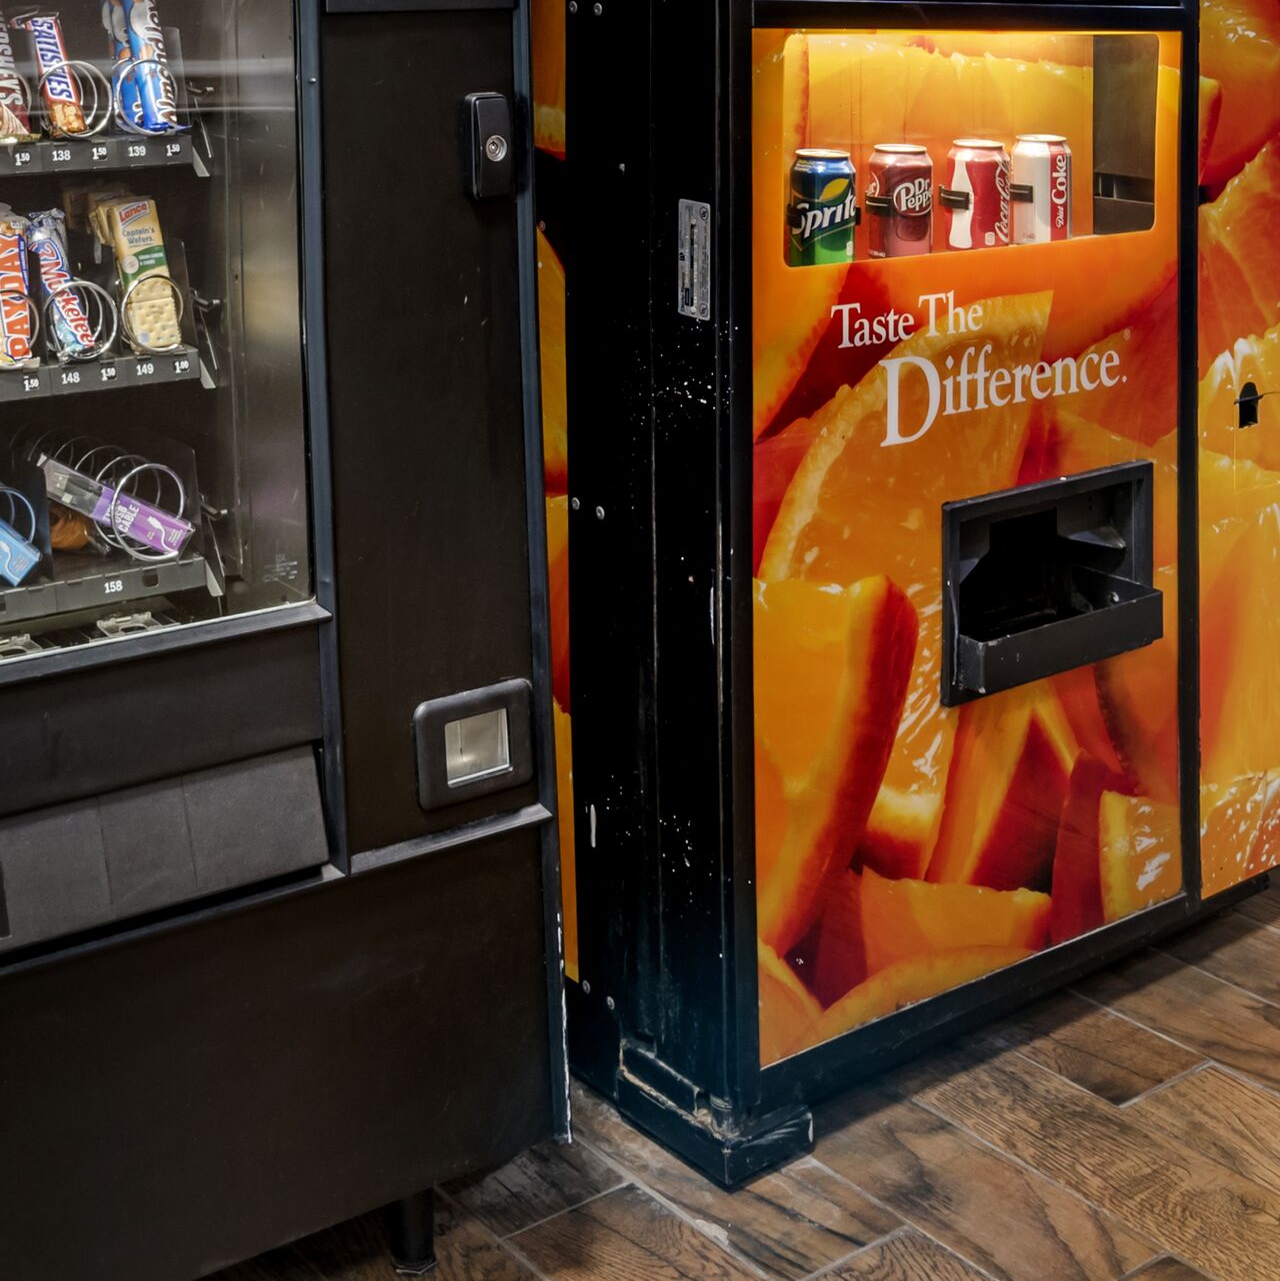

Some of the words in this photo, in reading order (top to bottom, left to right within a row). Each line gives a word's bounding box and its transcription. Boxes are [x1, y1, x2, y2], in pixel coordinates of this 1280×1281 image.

[32, 18, 75, 101] SATISIES
[52, 150, 71, 161] 138
[128, 146, 146, 156] 139
[915, 178, 930, 197] Dr
[1052, 155, 1067, 205] Coke
[120, 201, 148, 222] Lance
[122, 227, 155, 239] Captain's
[831, 302, 915, 349] Taste
[918, 290, 984, 339] The
[61, 372, 80, 384] 148
[136, 364, 154, 375] 149
[879, 344, 1127, 448] Difference.
[118, 503, 139, 533] CABLE
[104, 580, 123, 593] 158
